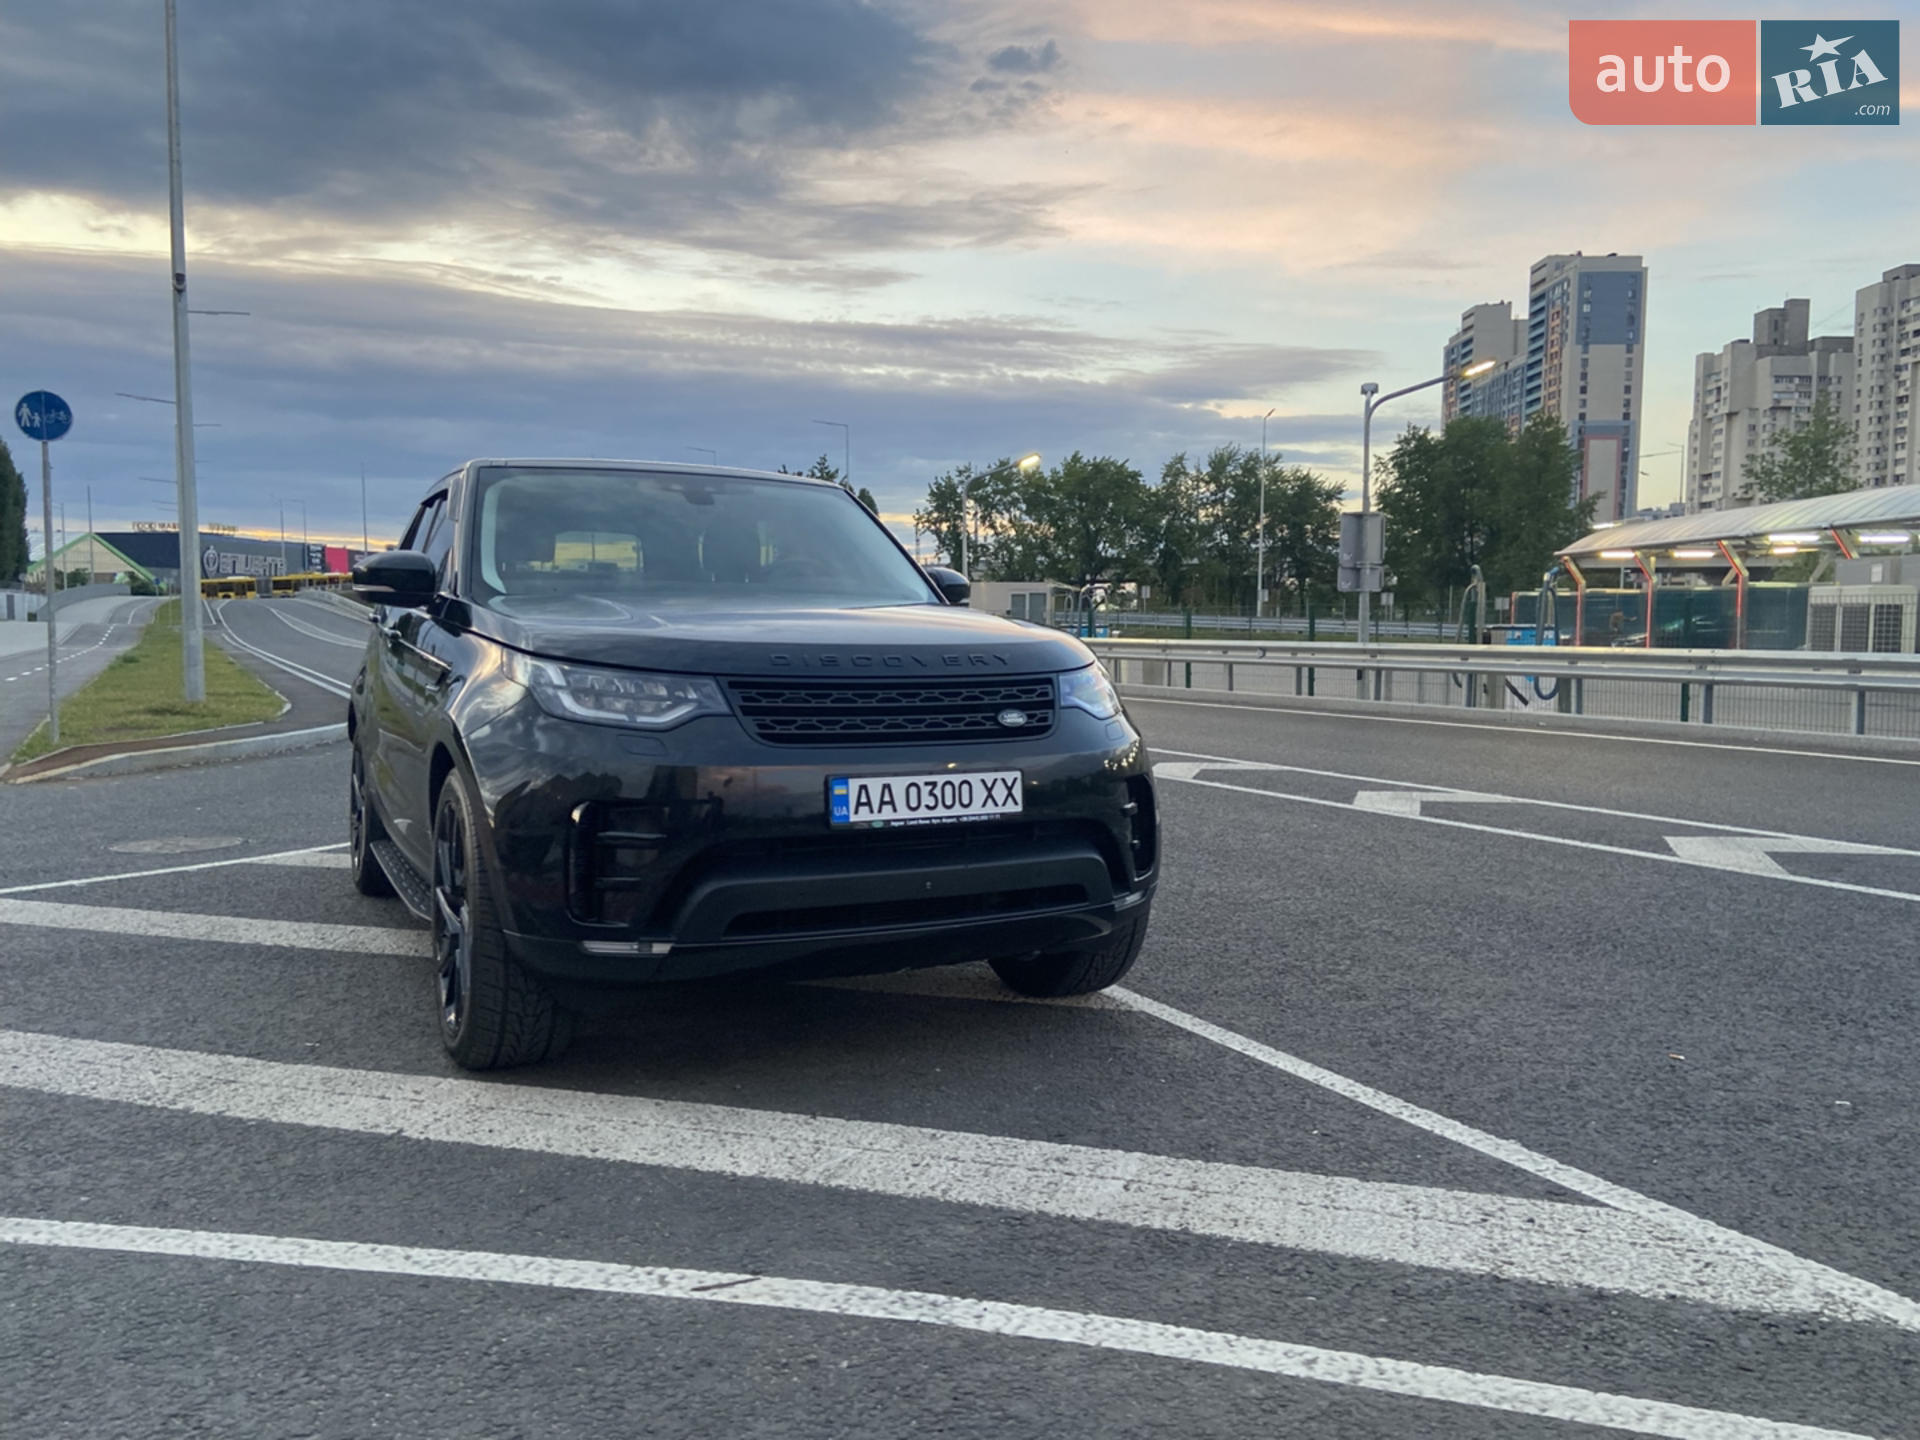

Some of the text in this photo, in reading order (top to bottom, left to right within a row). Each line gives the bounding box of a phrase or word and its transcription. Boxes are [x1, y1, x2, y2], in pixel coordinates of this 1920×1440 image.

[768, 653, 1010, 668] DISCOVERY
[853, 776, 1019, 815] AA 0300 XX
[833, 806, 848, 816] UA
